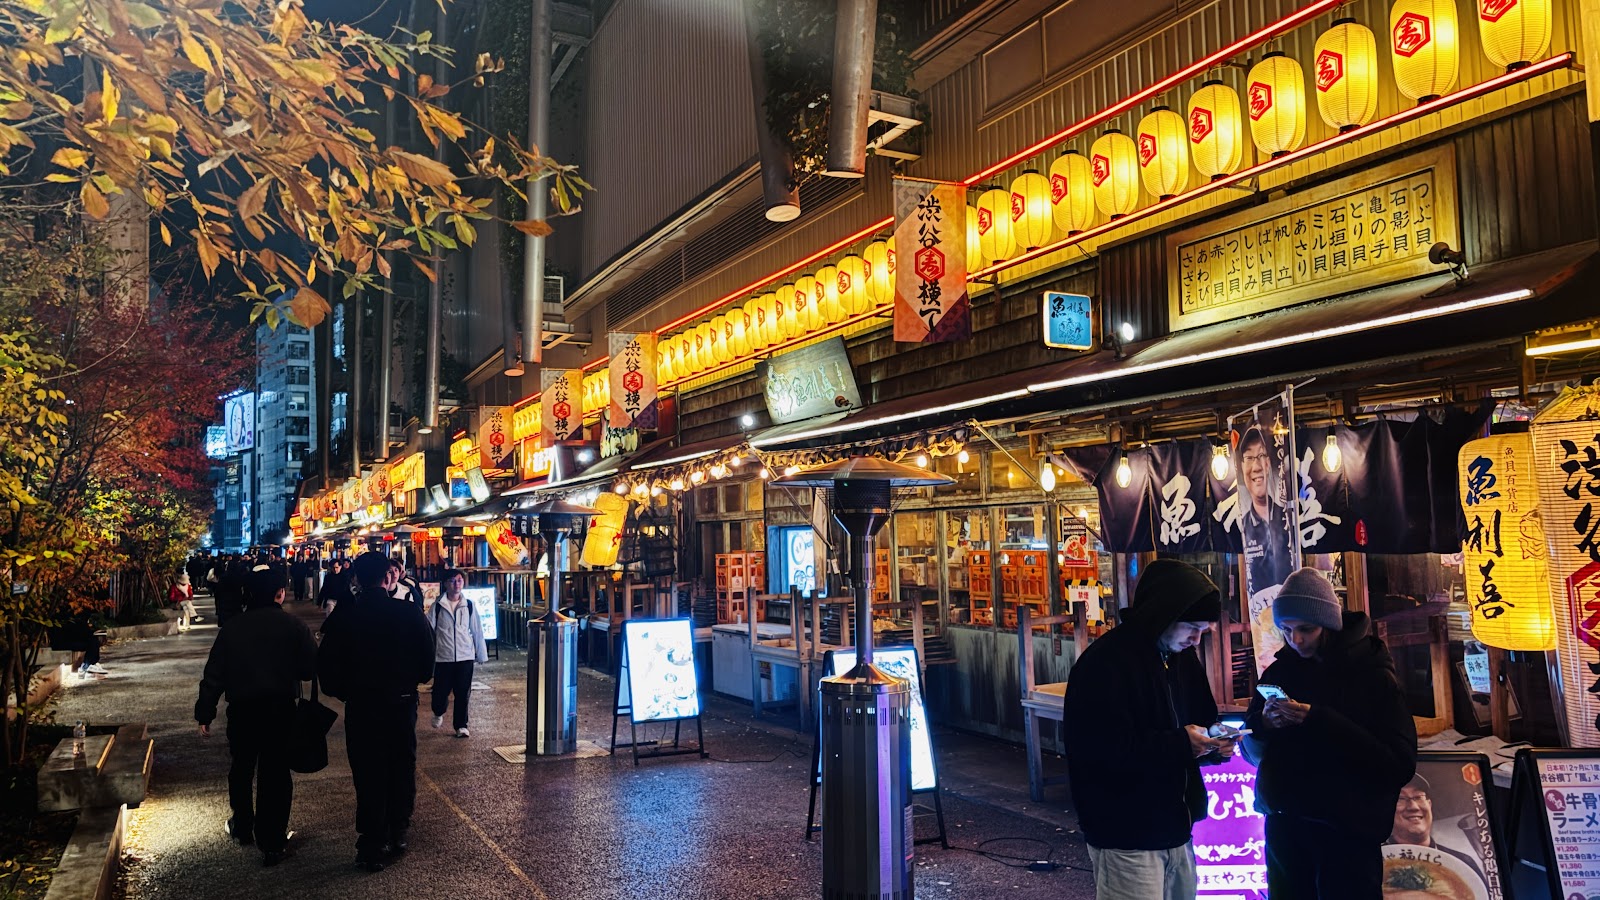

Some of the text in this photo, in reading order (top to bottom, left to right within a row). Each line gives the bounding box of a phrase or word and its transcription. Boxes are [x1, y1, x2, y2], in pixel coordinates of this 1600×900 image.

[1329, 206, 1348, 268] 石垣貝
[1350, 202, 1367, 262] とり貝
[1369, 195, 1390, 259] 亀の手
[1390, 187, 1410, 252] 石影貝
[1412, 182, 1432, 246] つぶ貝
[1210, 244, 1226, 299] 赤貝
[1226, 239, 1241, 295] つぶ貝
[1243, 235, 1258, 291] しじみ
[1258, 229, 1273, 287] ばい貝
[1274, 224, 1293, 283] 帆立
[1293, 218, 1308, 277] あさり
[1312, 213, 1329, 274] ミル貝
[1182, 252, 1195, 306] さざえ
[1197, 248, 1210, 302] あわび
[1503, 446, 1519, 514] 魚貝百貨店
[1464, 455, 1515, 620] 魚利喜
[1204, 772, 1256, 783] カラオケスナ
[1566, 793, 1600, 810] 牛骨
[1553, 812, 1600, 829] ラーメ
[1196, 872, 1266, 885] までやってま
